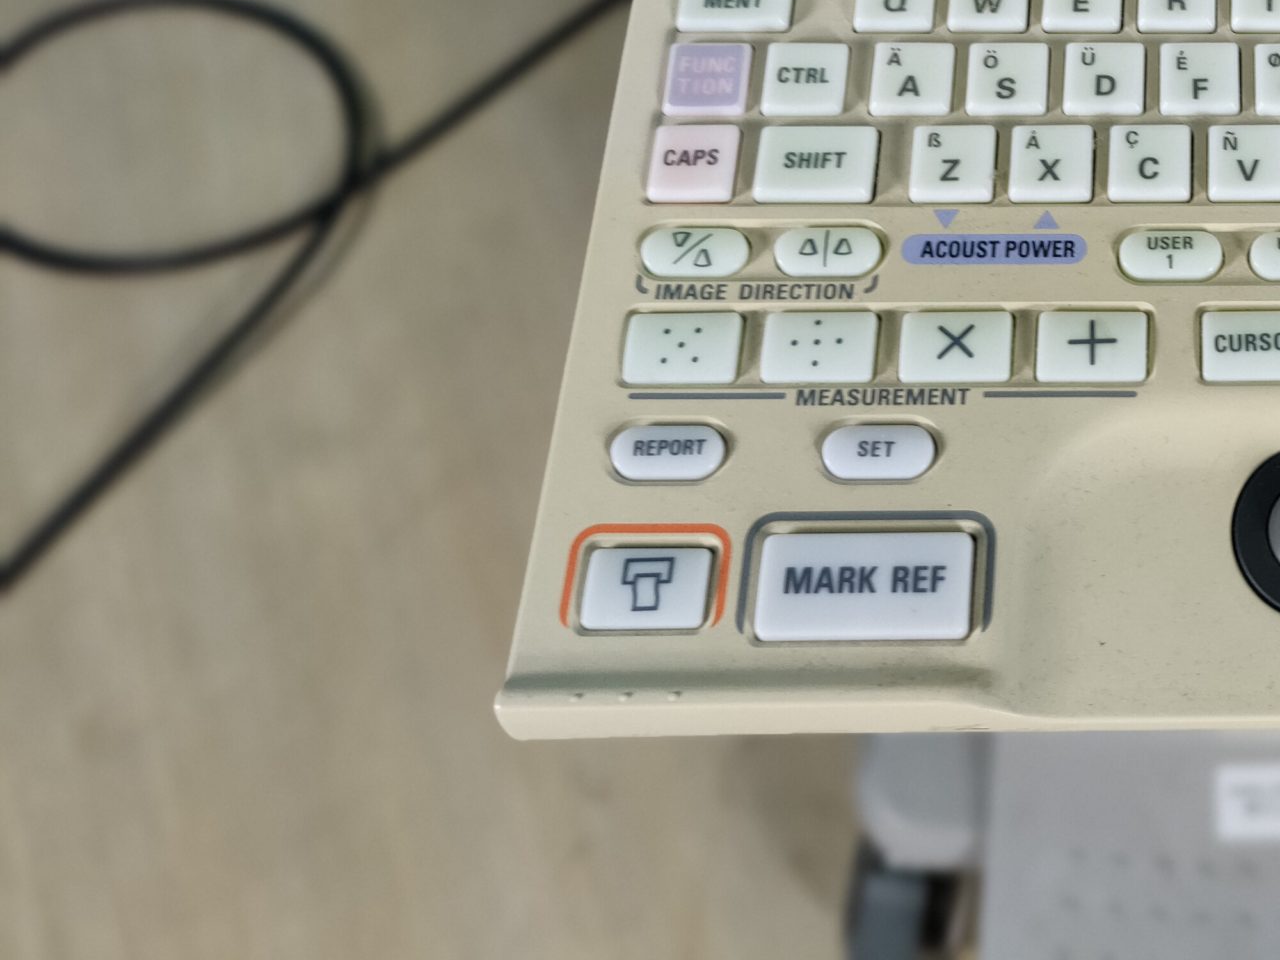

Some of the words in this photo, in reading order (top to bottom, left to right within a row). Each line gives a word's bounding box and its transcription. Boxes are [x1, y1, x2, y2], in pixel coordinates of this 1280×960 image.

[679, 56, 737, 74] FUNC
[776, 66, 829, 84] CTRL
[678, 77, 735, 95] TION
[897, 75, 921, 97] A
[995, 77, 1017, 100] S
[1094, 74, 1117, 97] D
[1191, 77, 1209, 100] F
[663, 148, 720, 167] CAPS
[783, 151, 847, 169] SHIFT
[939, 158, 961, 182] Z
[1037, 158, 1061, 182] X
[1137, 156, 1160, 180] C
[1236, 158, 1260, 182] V
[920, 240, 1001, 259] ACOUST
[1005, 240, 1075, 259] POWER
[1147, 235, 1193, 251] USER
[1165, 253, 1174, 269] 1
[654, 283, 729, 301] IMAGE
[739, 283, 855, 301] DIRECTION
[795, 388, 971, 407] MEASUREMENT
[633, 438, 708, 457] REPORT
[857, 440, 896, 458] SET
[783, 565, 878, 595] MARK
[890, 565, 947, 594] REF
